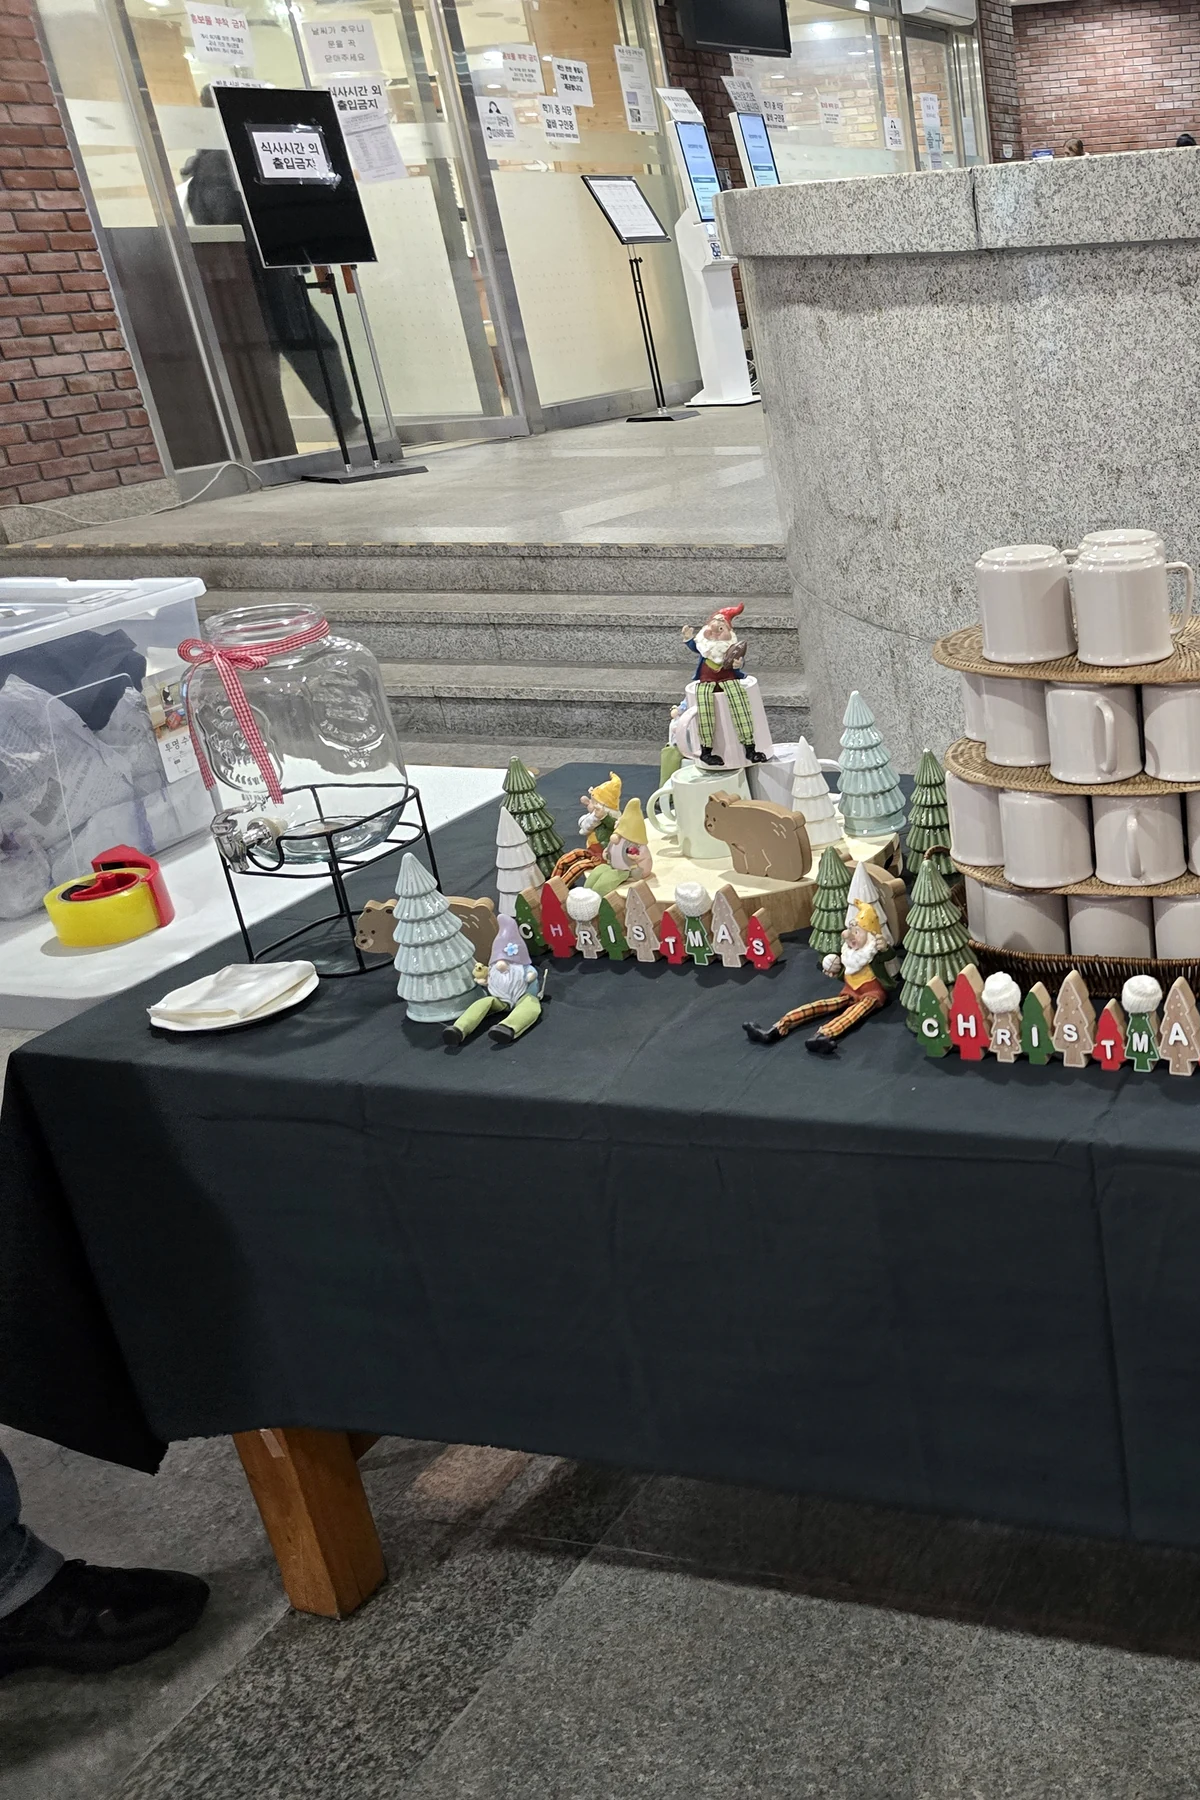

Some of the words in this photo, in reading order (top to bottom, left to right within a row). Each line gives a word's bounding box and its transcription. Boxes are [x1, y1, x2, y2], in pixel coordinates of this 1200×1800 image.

[191, 13, 213, 26] 홍보물
[214, 17, 230, 28] 부착
[231, 19, 247, 30] 금지
[311, 26, 336, 36] 날씨가
[340, 24, 365, 34] 추우니
[327, 40, 344, 49] 문을
[324, 53, 366, 64] 닫아주세요
[371, 84, 383, 97] 외
[337, 98, 379, 111] 출입금지
[554, 104, 561, 115] 중
[561, 104, 573, 116] 식당
[558, 119, 575, 131] 구인중
[261, 141, 306, 155] 식사시간
[272, 157, 317, 171] 출입금지
[164, 738, 180, 753] 투명
[518, 923, 765, 956] CHRISTMAS
